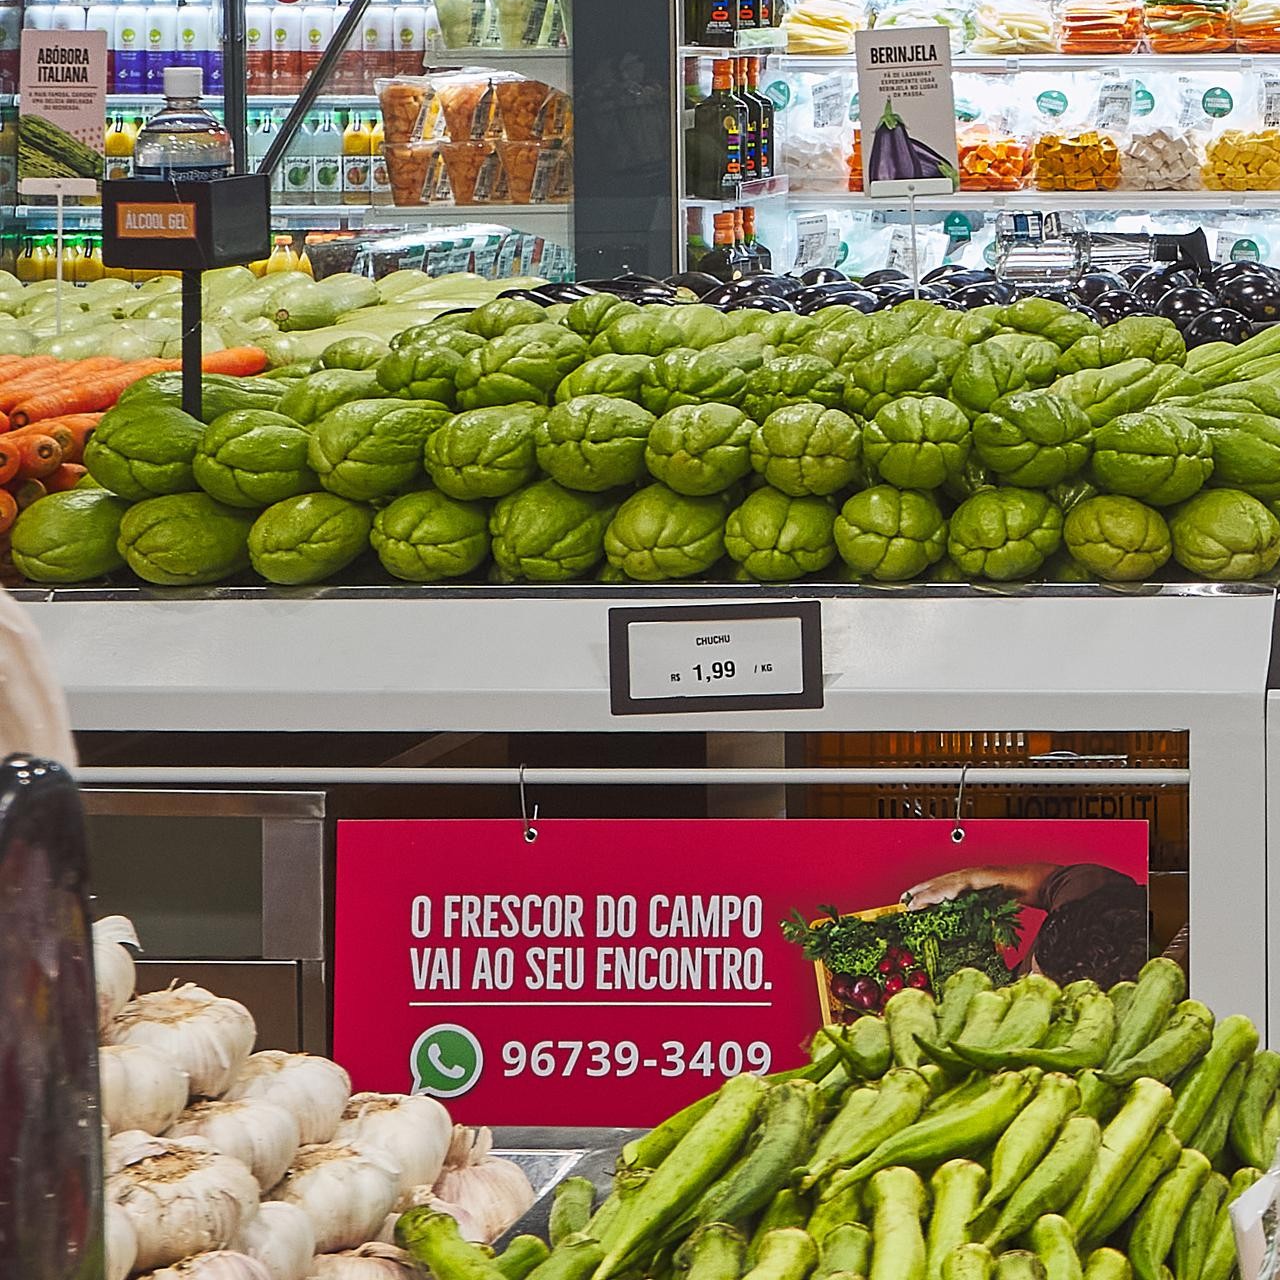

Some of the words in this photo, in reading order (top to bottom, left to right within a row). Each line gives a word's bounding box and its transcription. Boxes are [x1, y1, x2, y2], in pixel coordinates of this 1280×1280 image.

[37, 45, 90, 65] ABÓBORA
[870, 44, 938, 65] BERINJELA
[37, 66, 89, 83] ITALIANA
[881, 78, 918, 86] EXPERIMENTE
[125, 209, 165, 230] ÁLCOOL
[168, 210, 188, 230] GEL
[695, 634, 731, 646] CHUCHU
[670, 673, 681, 682] R$
[692, 660, 736, 683] 1,99
[761, 663, 773, 672] KG
[411, 894, 432, 938] O
[443, 894, 585, 939] FRESCOR
[596, 894, 638, 938] DO
[648, 894, 763, 938] CAMPO
[409, 947, 461, 990] VAI
[471, 947, 514, 990] AO
[525, 947, 585, 990] SEU
[596, 947, 773, 991] ENCONTRO.
[502, 1040, 772, 1078] 96739-3409
